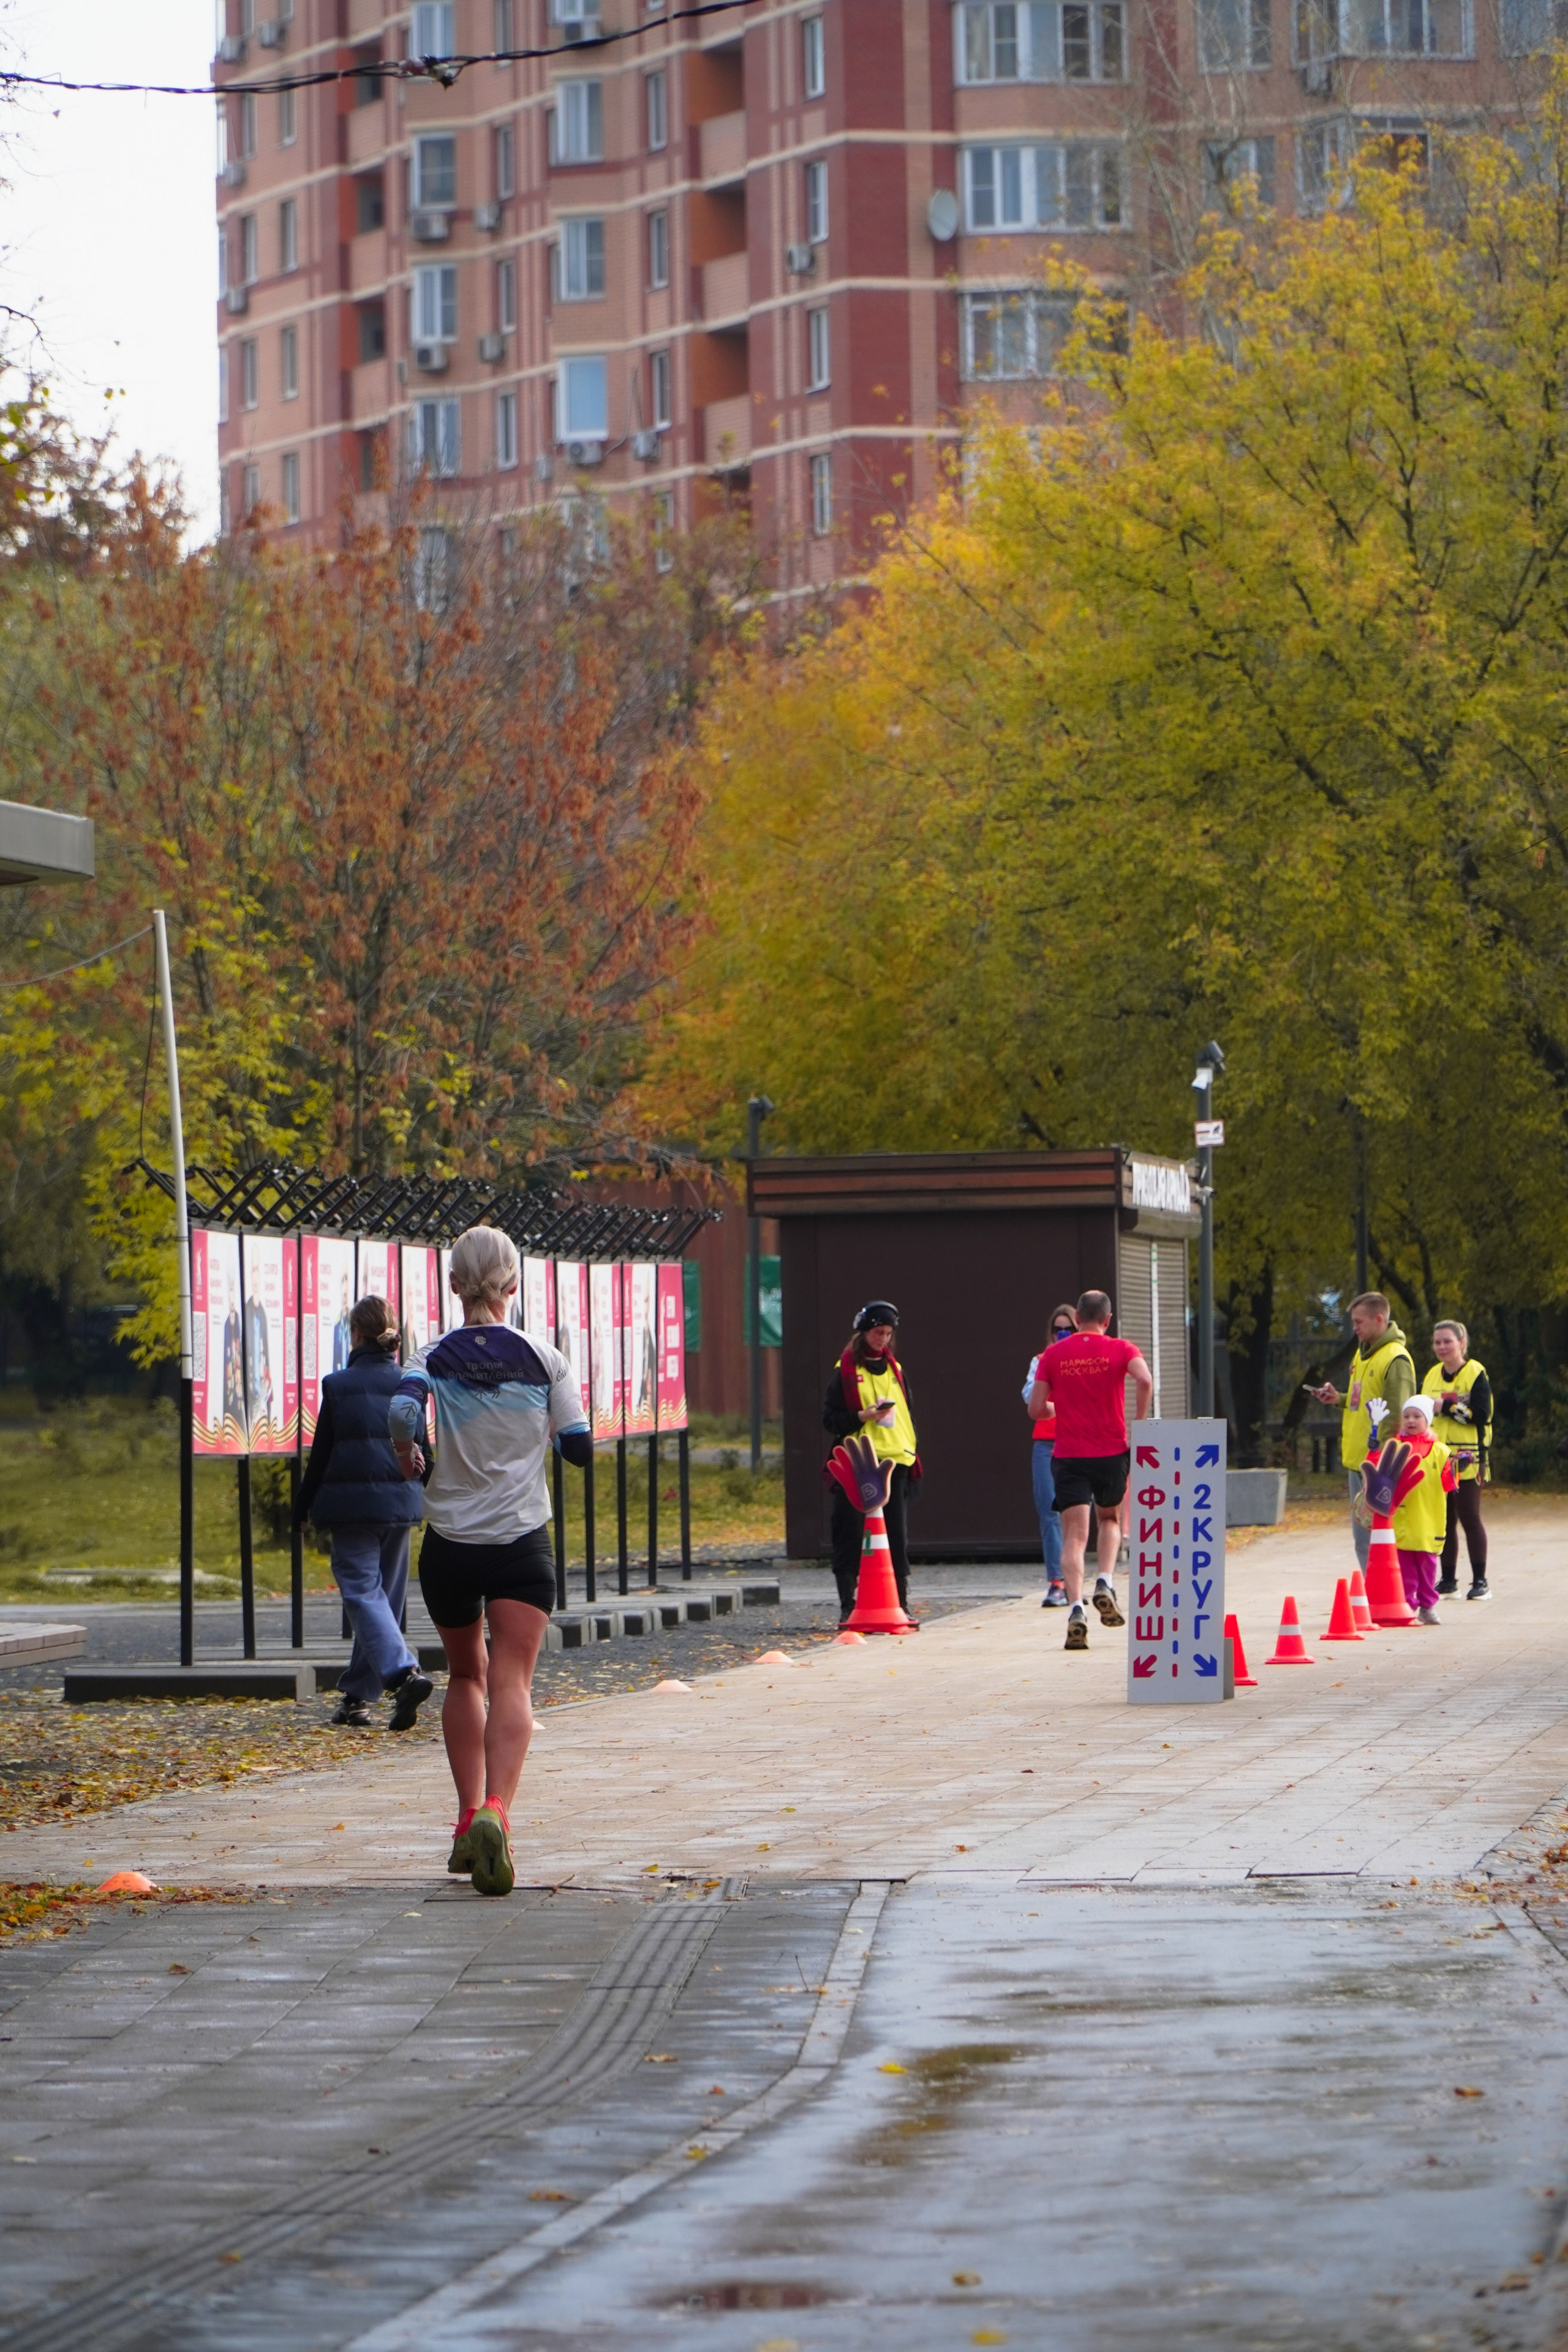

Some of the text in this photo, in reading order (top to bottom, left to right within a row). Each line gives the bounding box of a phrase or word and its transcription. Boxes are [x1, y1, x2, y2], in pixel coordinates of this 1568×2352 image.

[466, 1362, 503, 1371] тропы
[1060, 1356, 1109, 1368] МАРАФОН
[1061, 1366, 1101, 1376] МОСКВА
[1136, 1485, 1166, 1640] ФИНИШ
